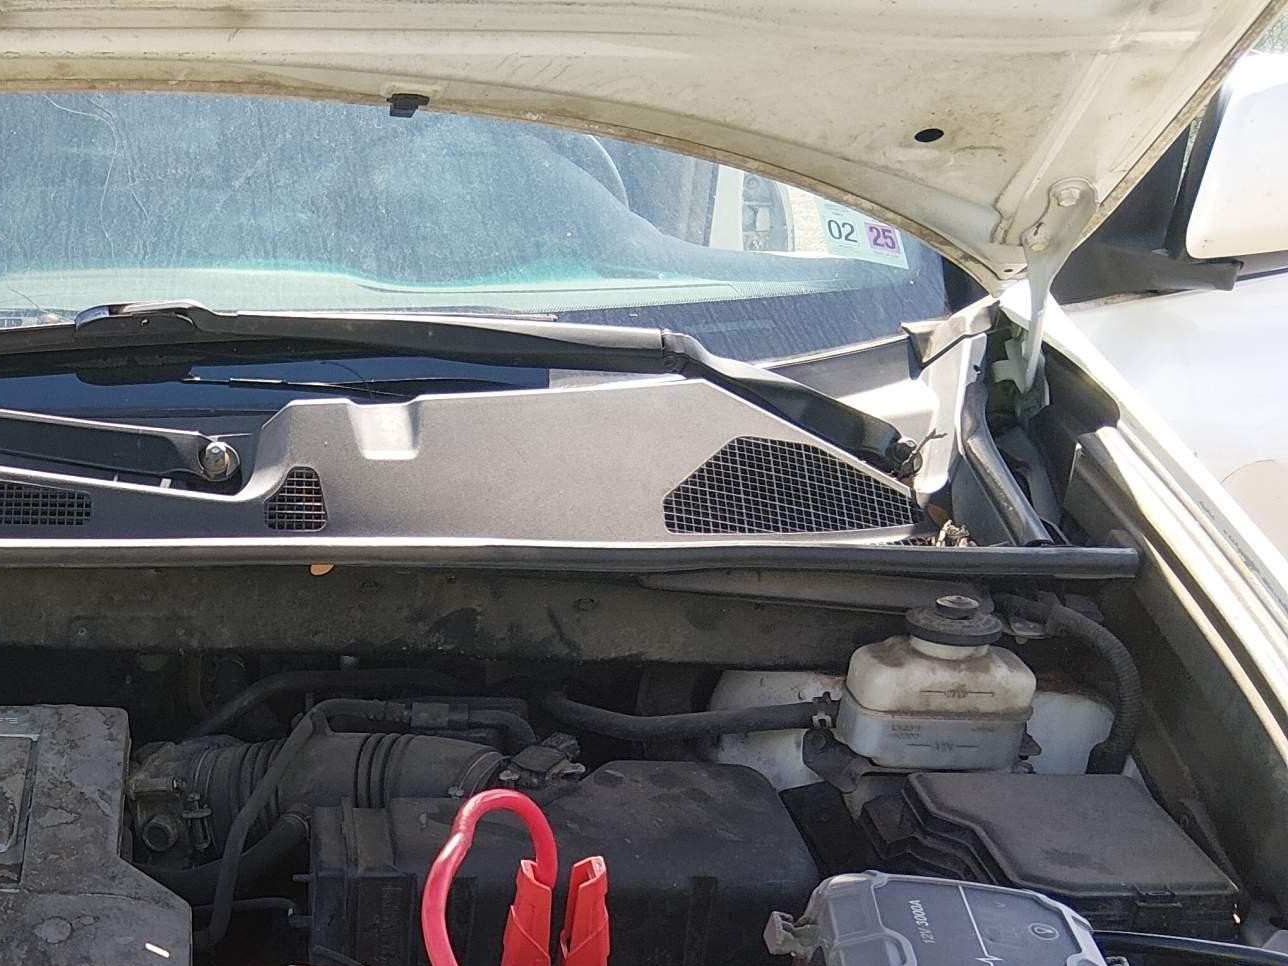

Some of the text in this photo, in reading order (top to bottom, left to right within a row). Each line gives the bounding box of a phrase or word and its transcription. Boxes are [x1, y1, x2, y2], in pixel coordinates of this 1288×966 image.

[827, 219, 896, 250] 02 25
[908, 899, 929, 928] 3000A
